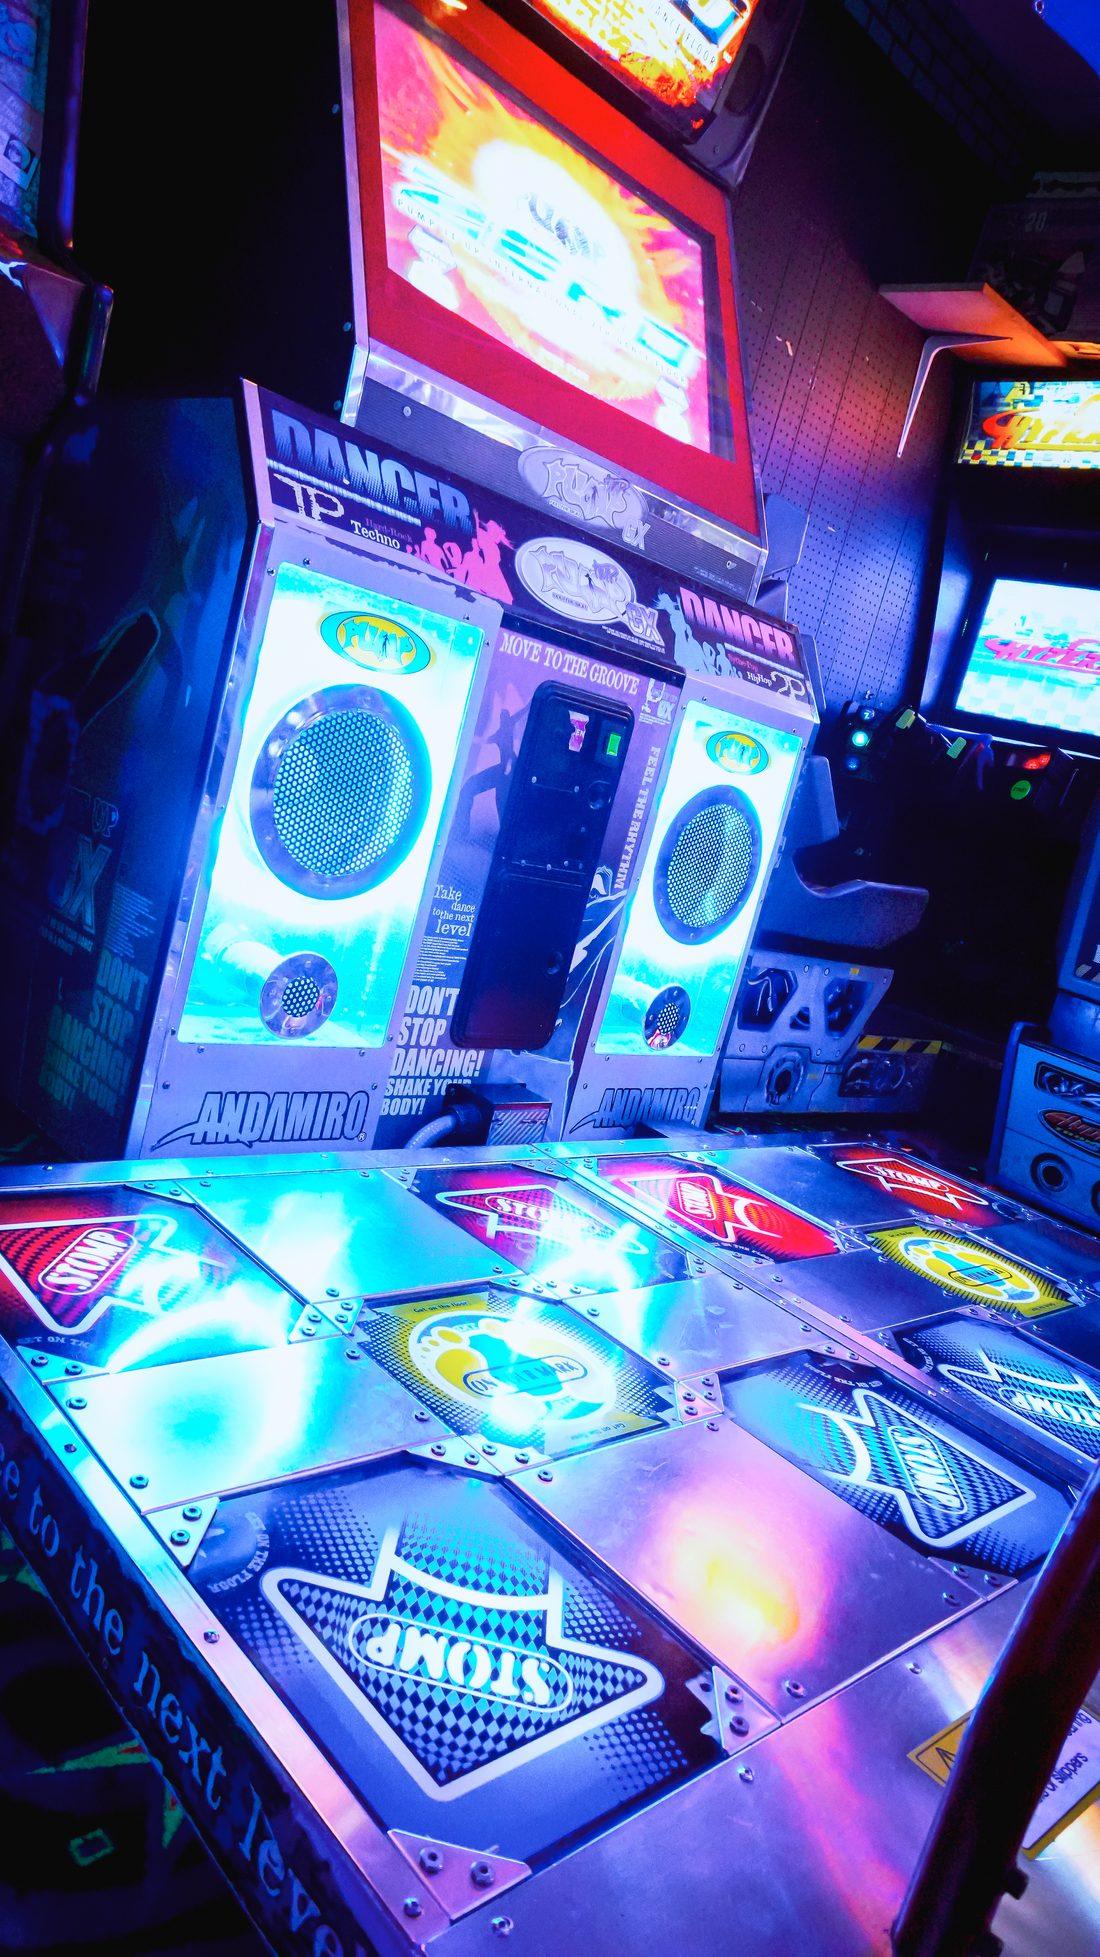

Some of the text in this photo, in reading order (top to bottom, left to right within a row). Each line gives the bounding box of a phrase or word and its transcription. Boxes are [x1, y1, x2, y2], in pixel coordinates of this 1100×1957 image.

[350, 519, 401, 550] Techno
[680, 587, 799, 666] DANCER
[500, 632, 641, 695] MOVE TO THE GROOVE
[770, 671, 806, 702] 2P
[641, 746, 661, 786] FEEL
[633, 788, 650, 820] THE
[613, 820, 641, 890] RHYTHM
[432, 884, 462, 901] Take
[451, 901, 476, 913] dance
[435, 919, 473, 937] level
[455, 912, 475, 923] next
[404, 985, 460, 1016] DON'T
[398, 1017, 447, 1047] STOP
[390, 1048, 485, 1077] DANCING!
[384, 1076, 431, 1096] SHAKE
[152, 1089, 370, 1150] ANDAMIRO
[380, 1097, 425, 1116] BODY!
[873, 1165, 941, 1190] STOMP
[45, 1230, 129, 1291] STOMP
[437, 1302, 450, 1311] the
[49, 1336, 67, 1345] ON
[893, 1431, 962, 1508] STOMP
[365, 1622, 551, 1706] STOMP
[29, 1484, 345, 1957] to the next leve
[1054, 1752, 1089, 1785] slippers
